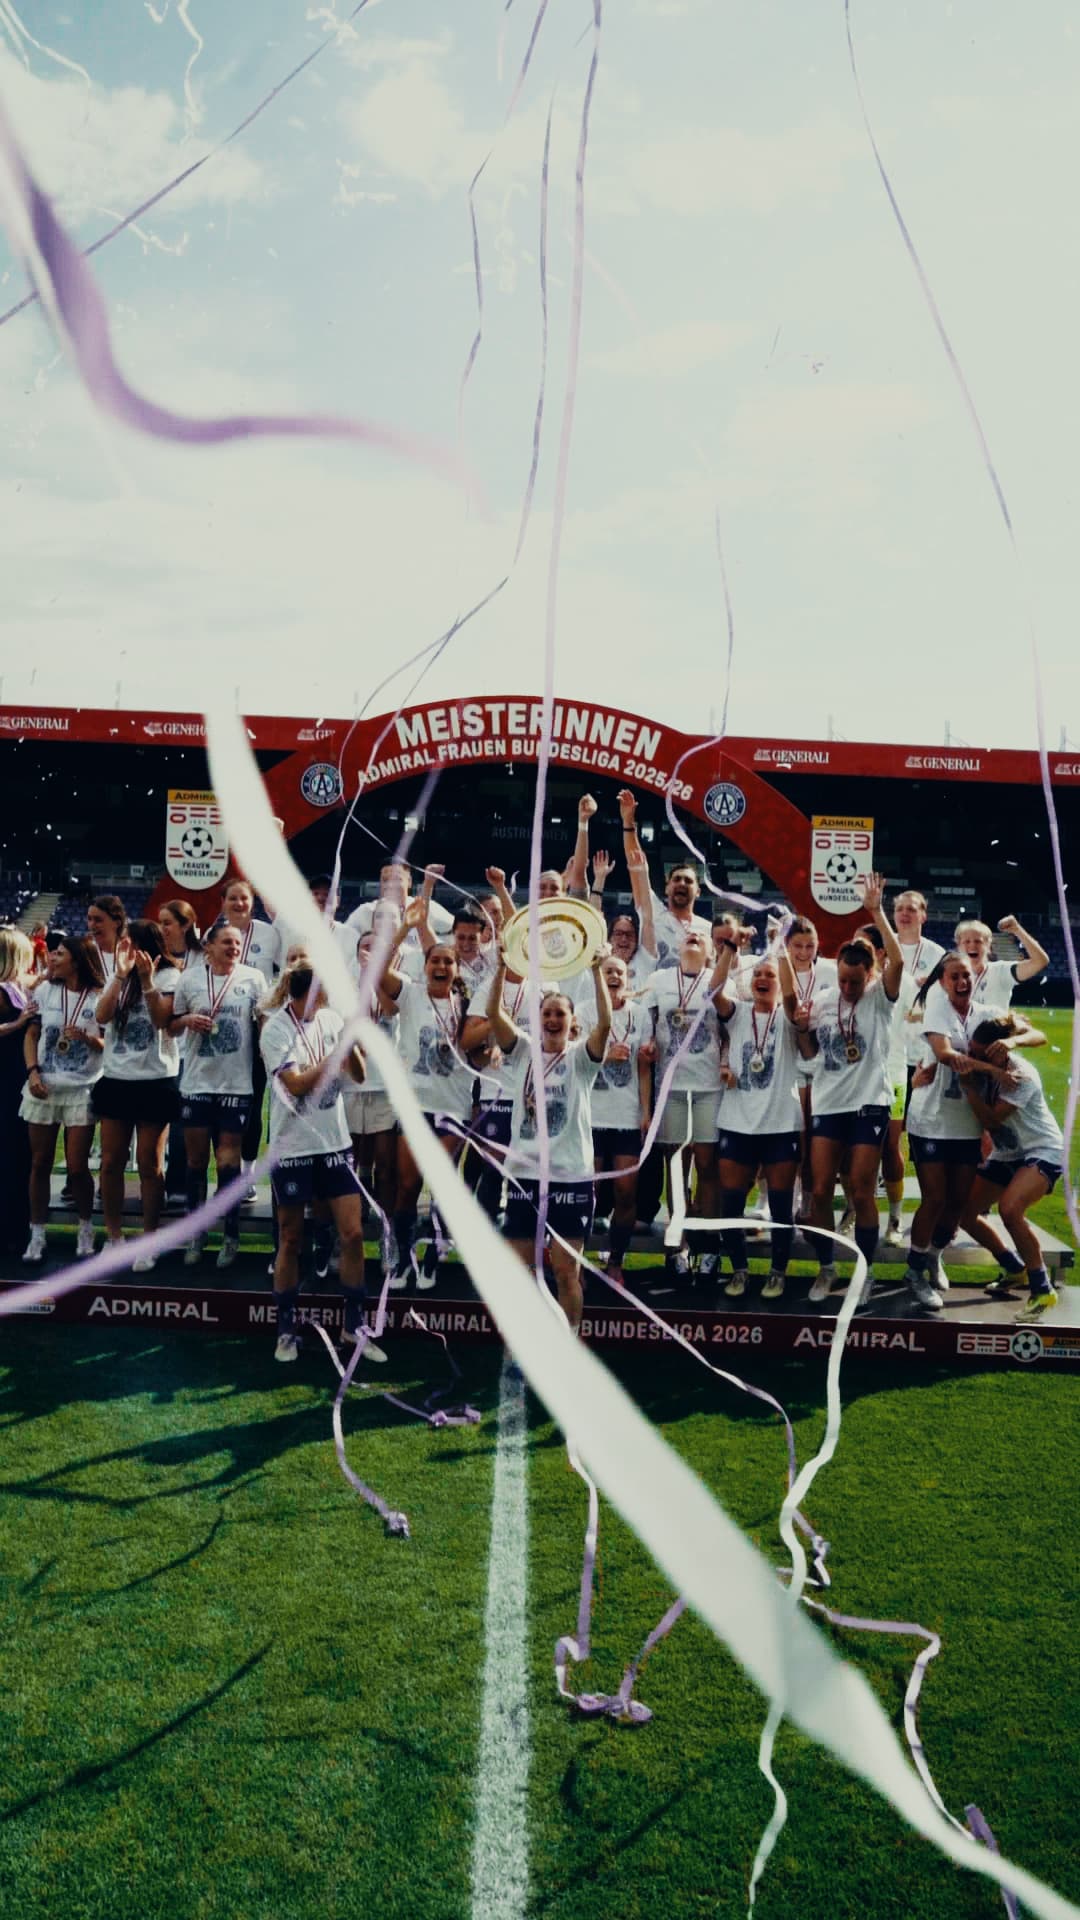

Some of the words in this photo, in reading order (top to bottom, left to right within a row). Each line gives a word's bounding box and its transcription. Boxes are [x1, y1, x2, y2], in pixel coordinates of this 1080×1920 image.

[11, 716, 69, 730] GENERALI
[162, 722, 206, 736] GENER
[394, 701, 662, 762] MEISTERINNEN
[771, 750, 829, 764] GENERALI
[922, 756, 981, 771] GENERALI
[357, 749, 435, 786] ADMIRAL
[438, 739, 506, 763] FRAUEN
[623, 759, 694, 801] 2025/26
[175, 792, 216, 801] ADMIRA
[820, 819, 868, 829] ADMIRAL
[491, 825, 532, 841] AUSTRI
[174, 869, 219, 877] BUNDESLIGA
[88, 1296, 219, 1323] ADMIRAL
[401, 1311, 492, 1333] ADMIRAL
[711, 1325, 763, 1344] 2026
[793, 1326, 926, 1353] ADMIRAL
